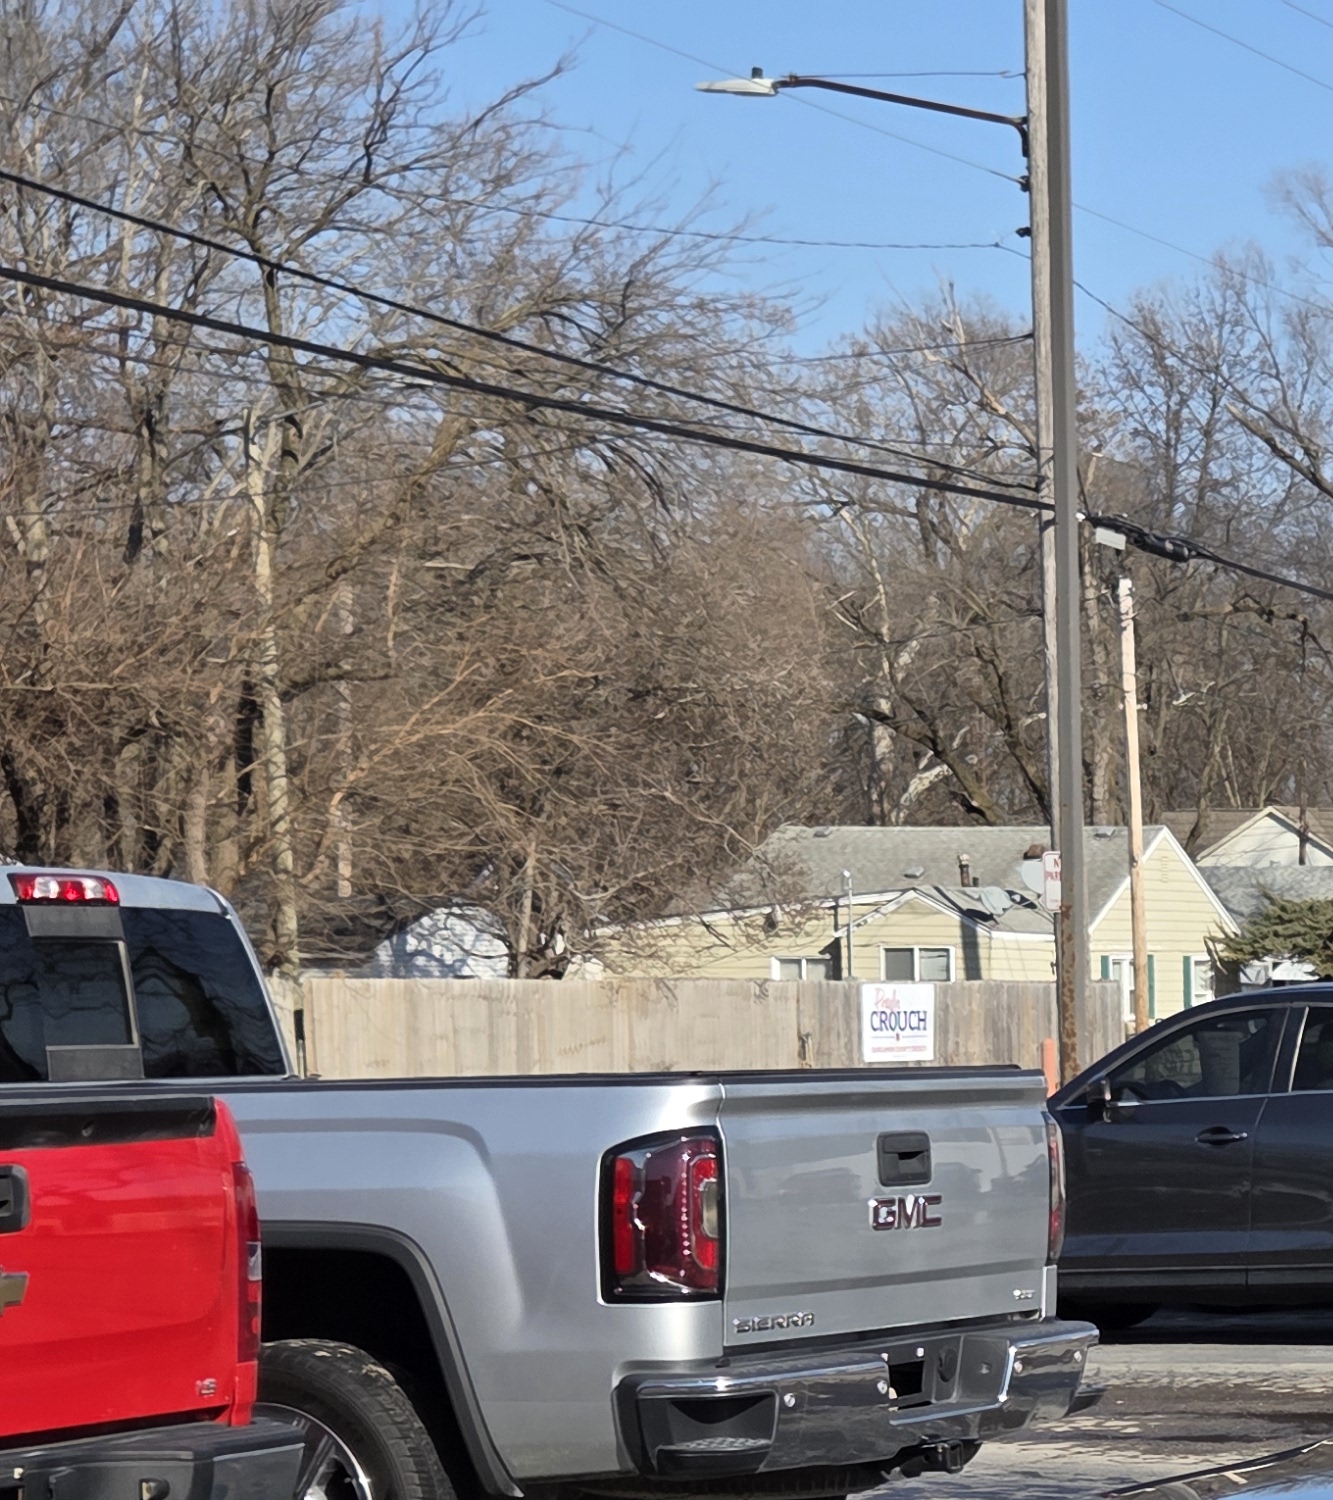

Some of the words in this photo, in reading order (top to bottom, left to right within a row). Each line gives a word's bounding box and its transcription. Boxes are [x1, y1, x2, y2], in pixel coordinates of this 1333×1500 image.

[870, 1010, 928, 1032] CROUCH
[868, 1194, 943, 1231] GMC
[733, 1311, 816, 1334] SIERRA
